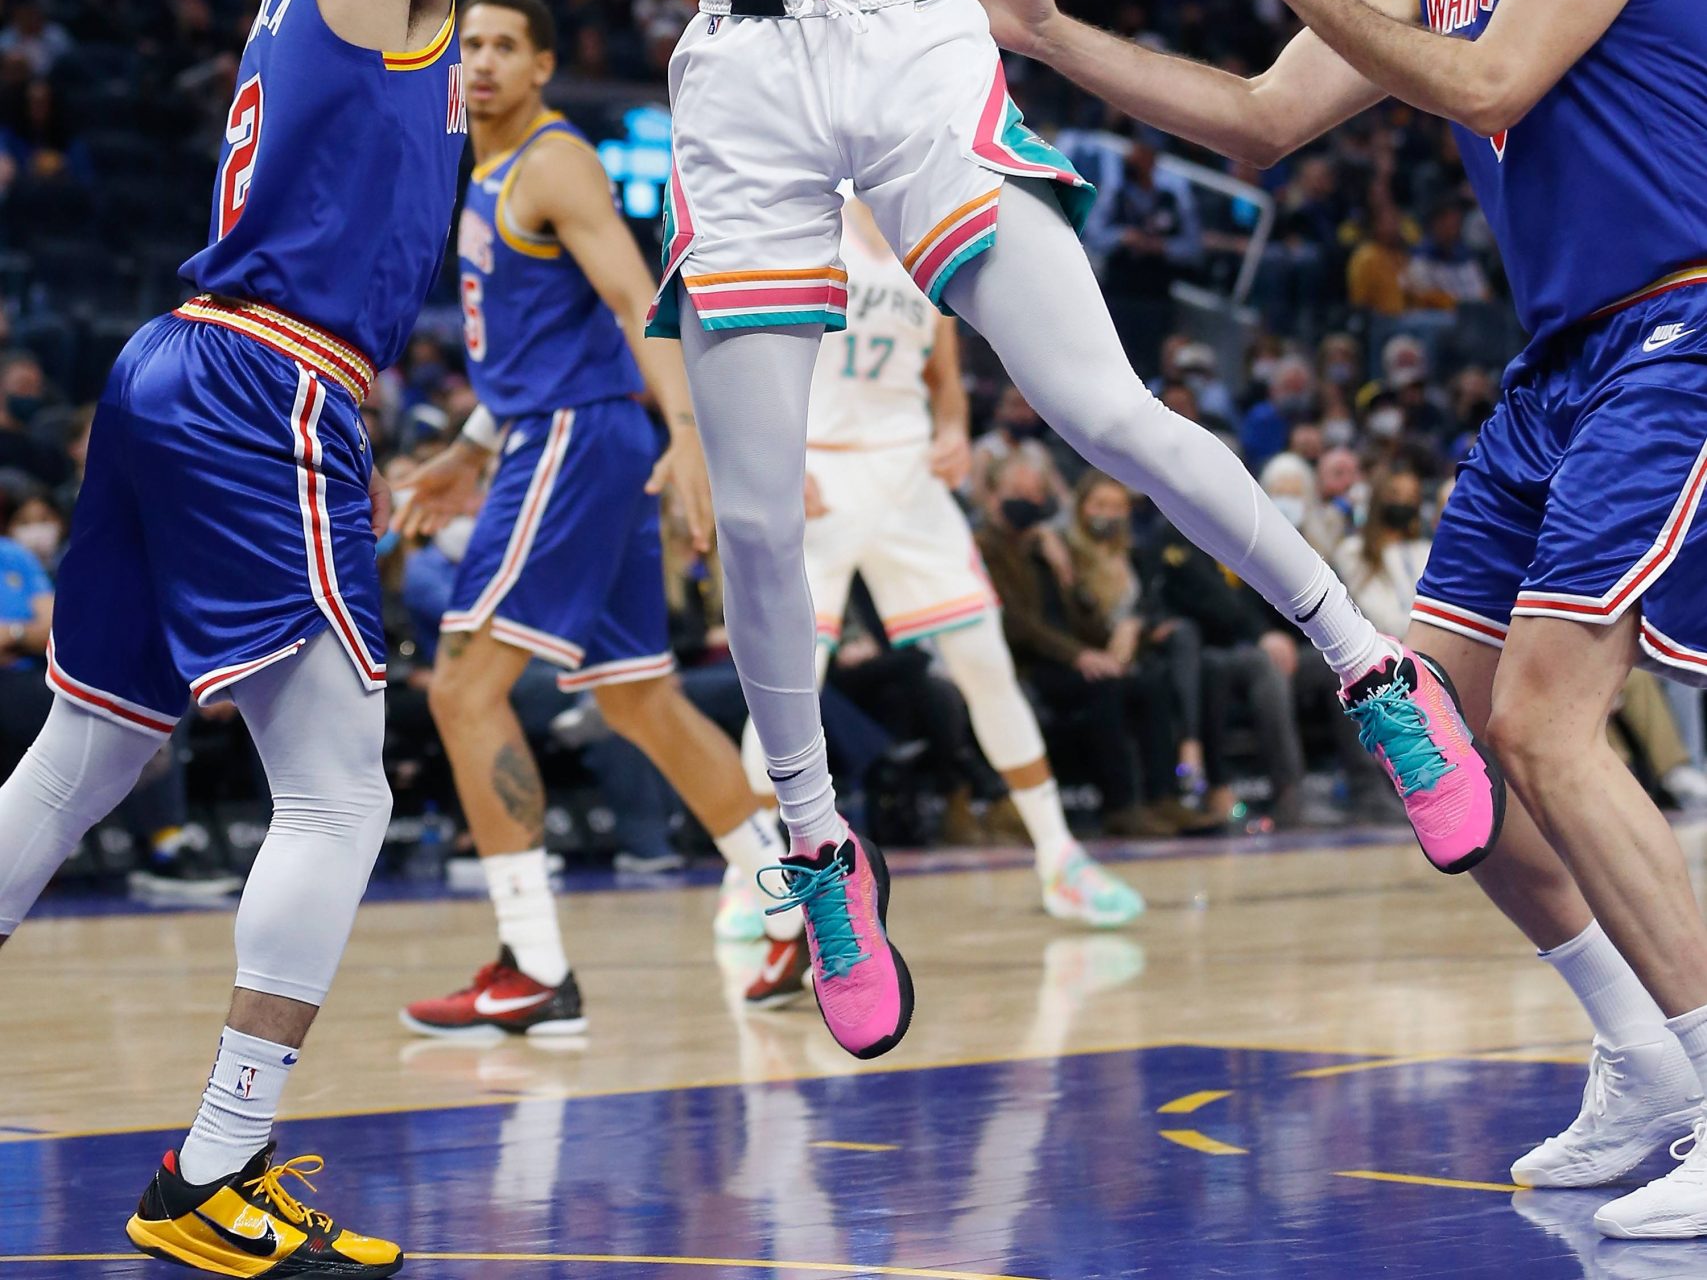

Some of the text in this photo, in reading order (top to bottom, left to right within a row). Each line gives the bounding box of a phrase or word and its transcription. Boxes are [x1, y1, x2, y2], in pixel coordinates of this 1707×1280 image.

[217, 71, 264, 243] 2
[1649, 322, 1685, 342] NIKE
[840, 334, 896, 380] 17
